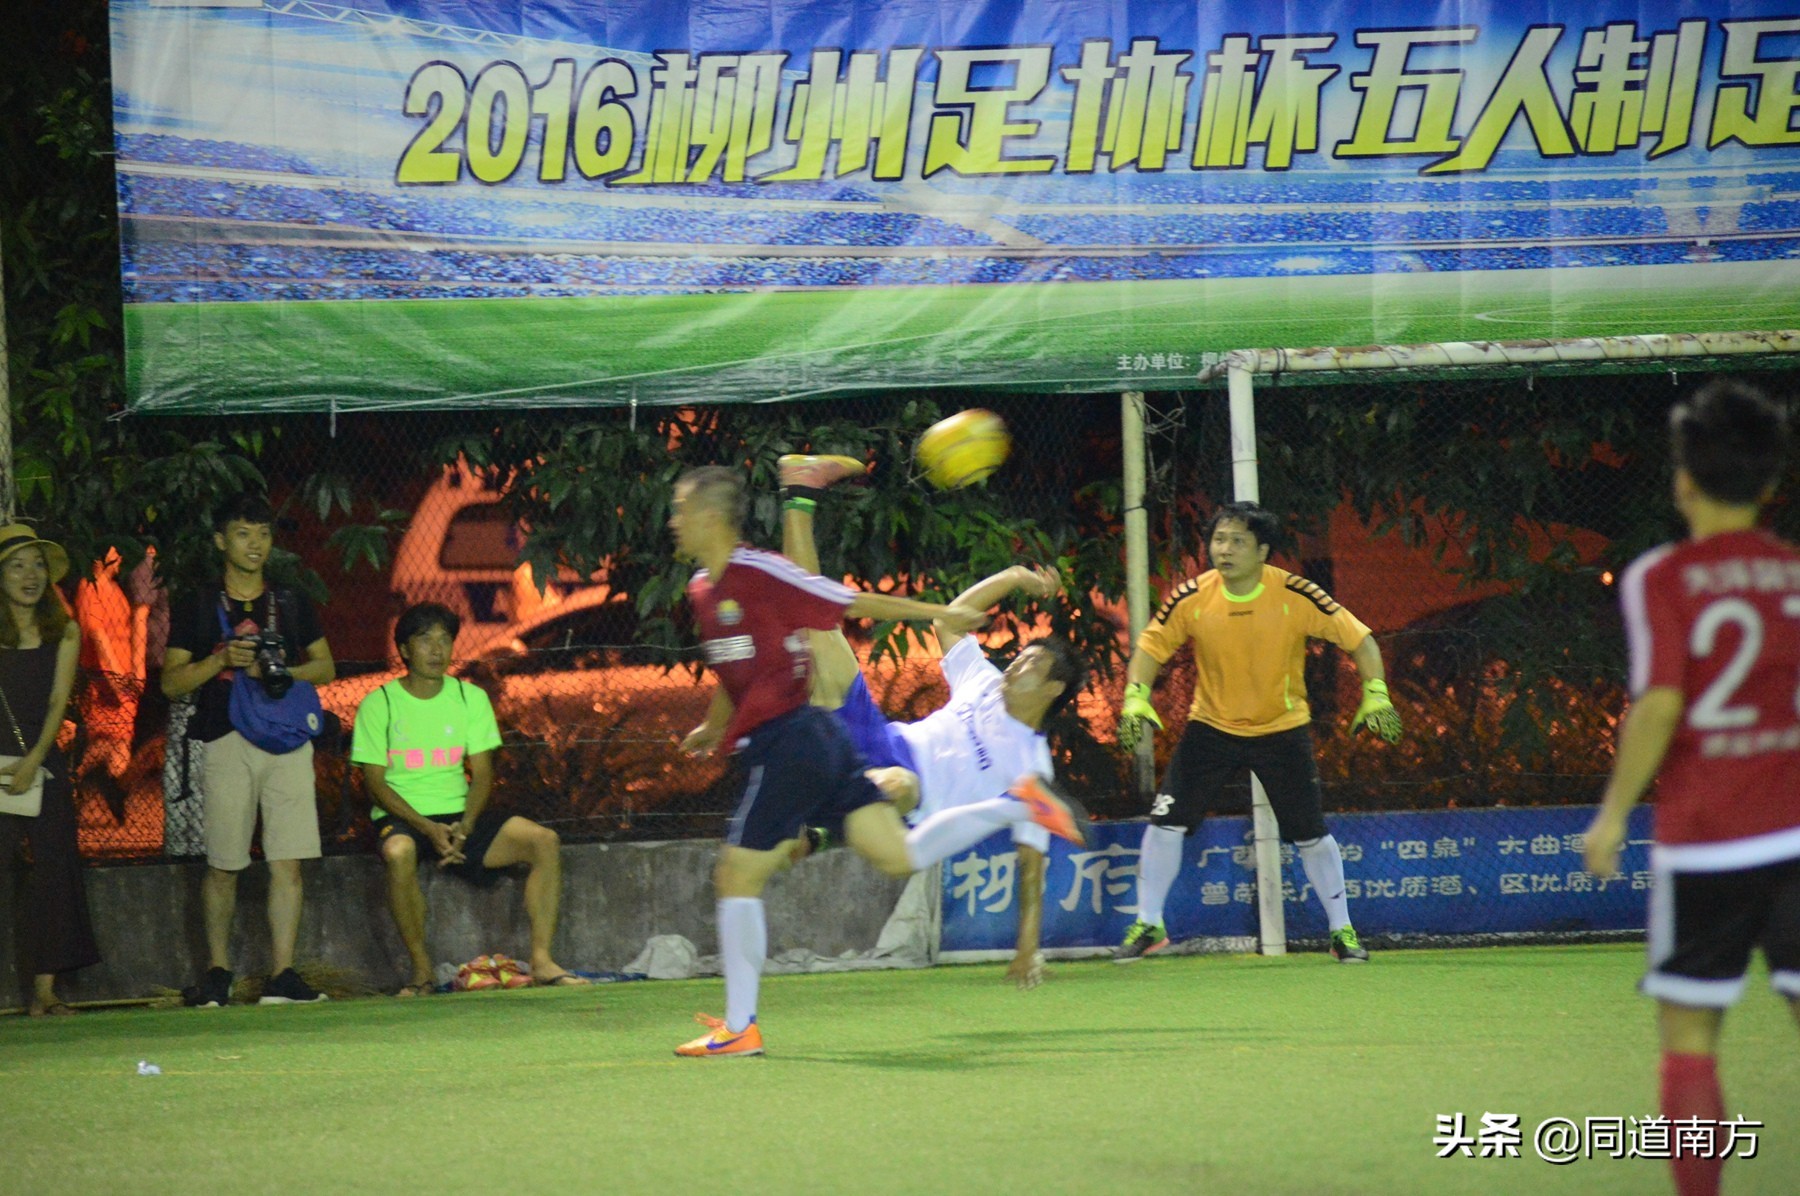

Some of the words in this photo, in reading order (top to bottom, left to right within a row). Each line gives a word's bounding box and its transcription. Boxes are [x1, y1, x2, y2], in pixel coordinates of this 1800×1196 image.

[397, 17, 1800, 187] 2016柳州足协杯五人制足
[1689, 597, 1800, 730] 2
